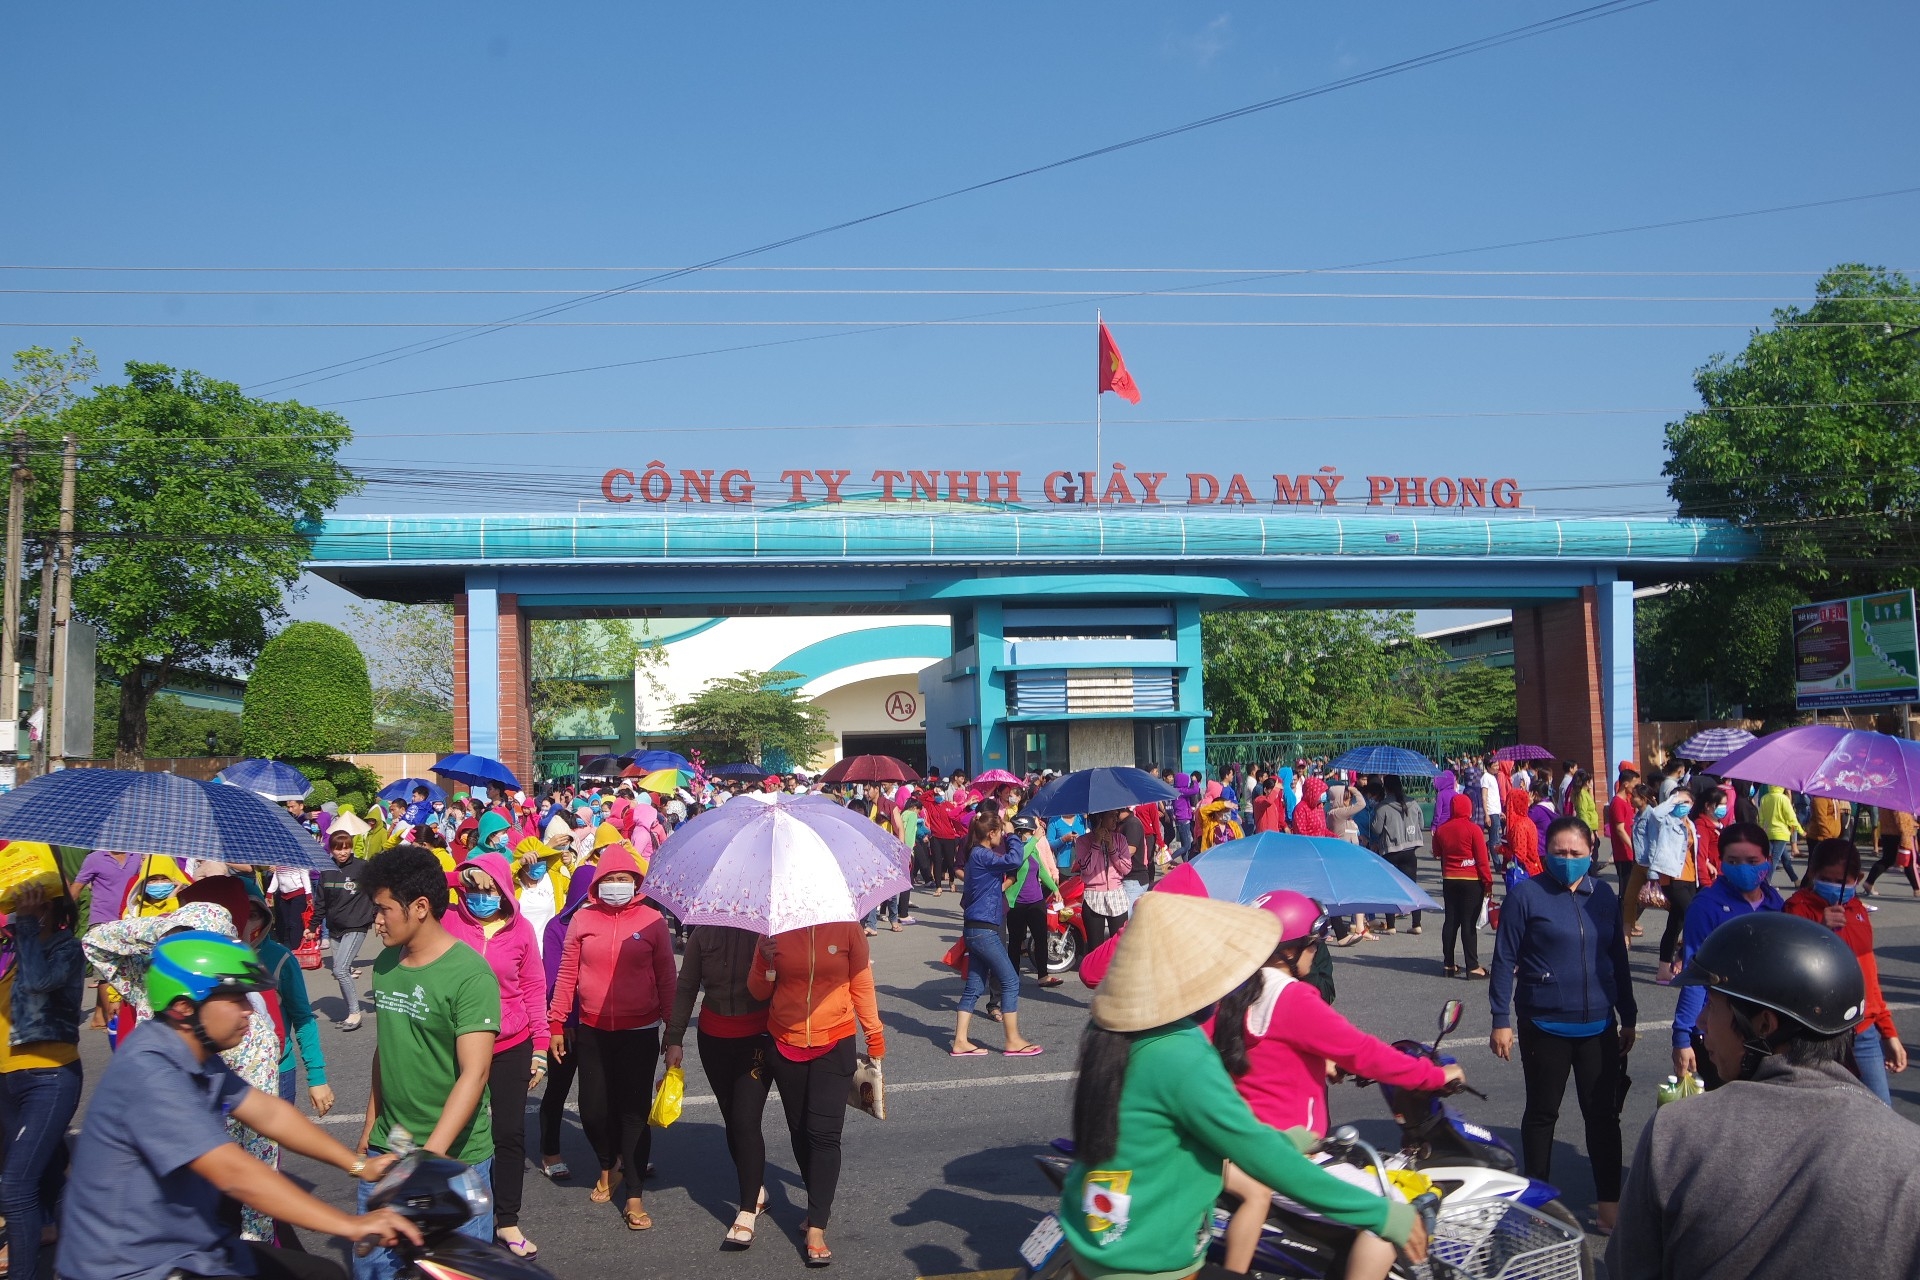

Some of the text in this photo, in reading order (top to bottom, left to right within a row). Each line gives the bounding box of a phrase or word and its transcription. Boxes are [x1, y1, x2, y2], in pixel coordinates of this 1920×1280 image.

[601, 460, 1522, 508] CÔNG TY TNHH GIÀY DA MỸ PHONG
[891, 695, 912, 714] A3
